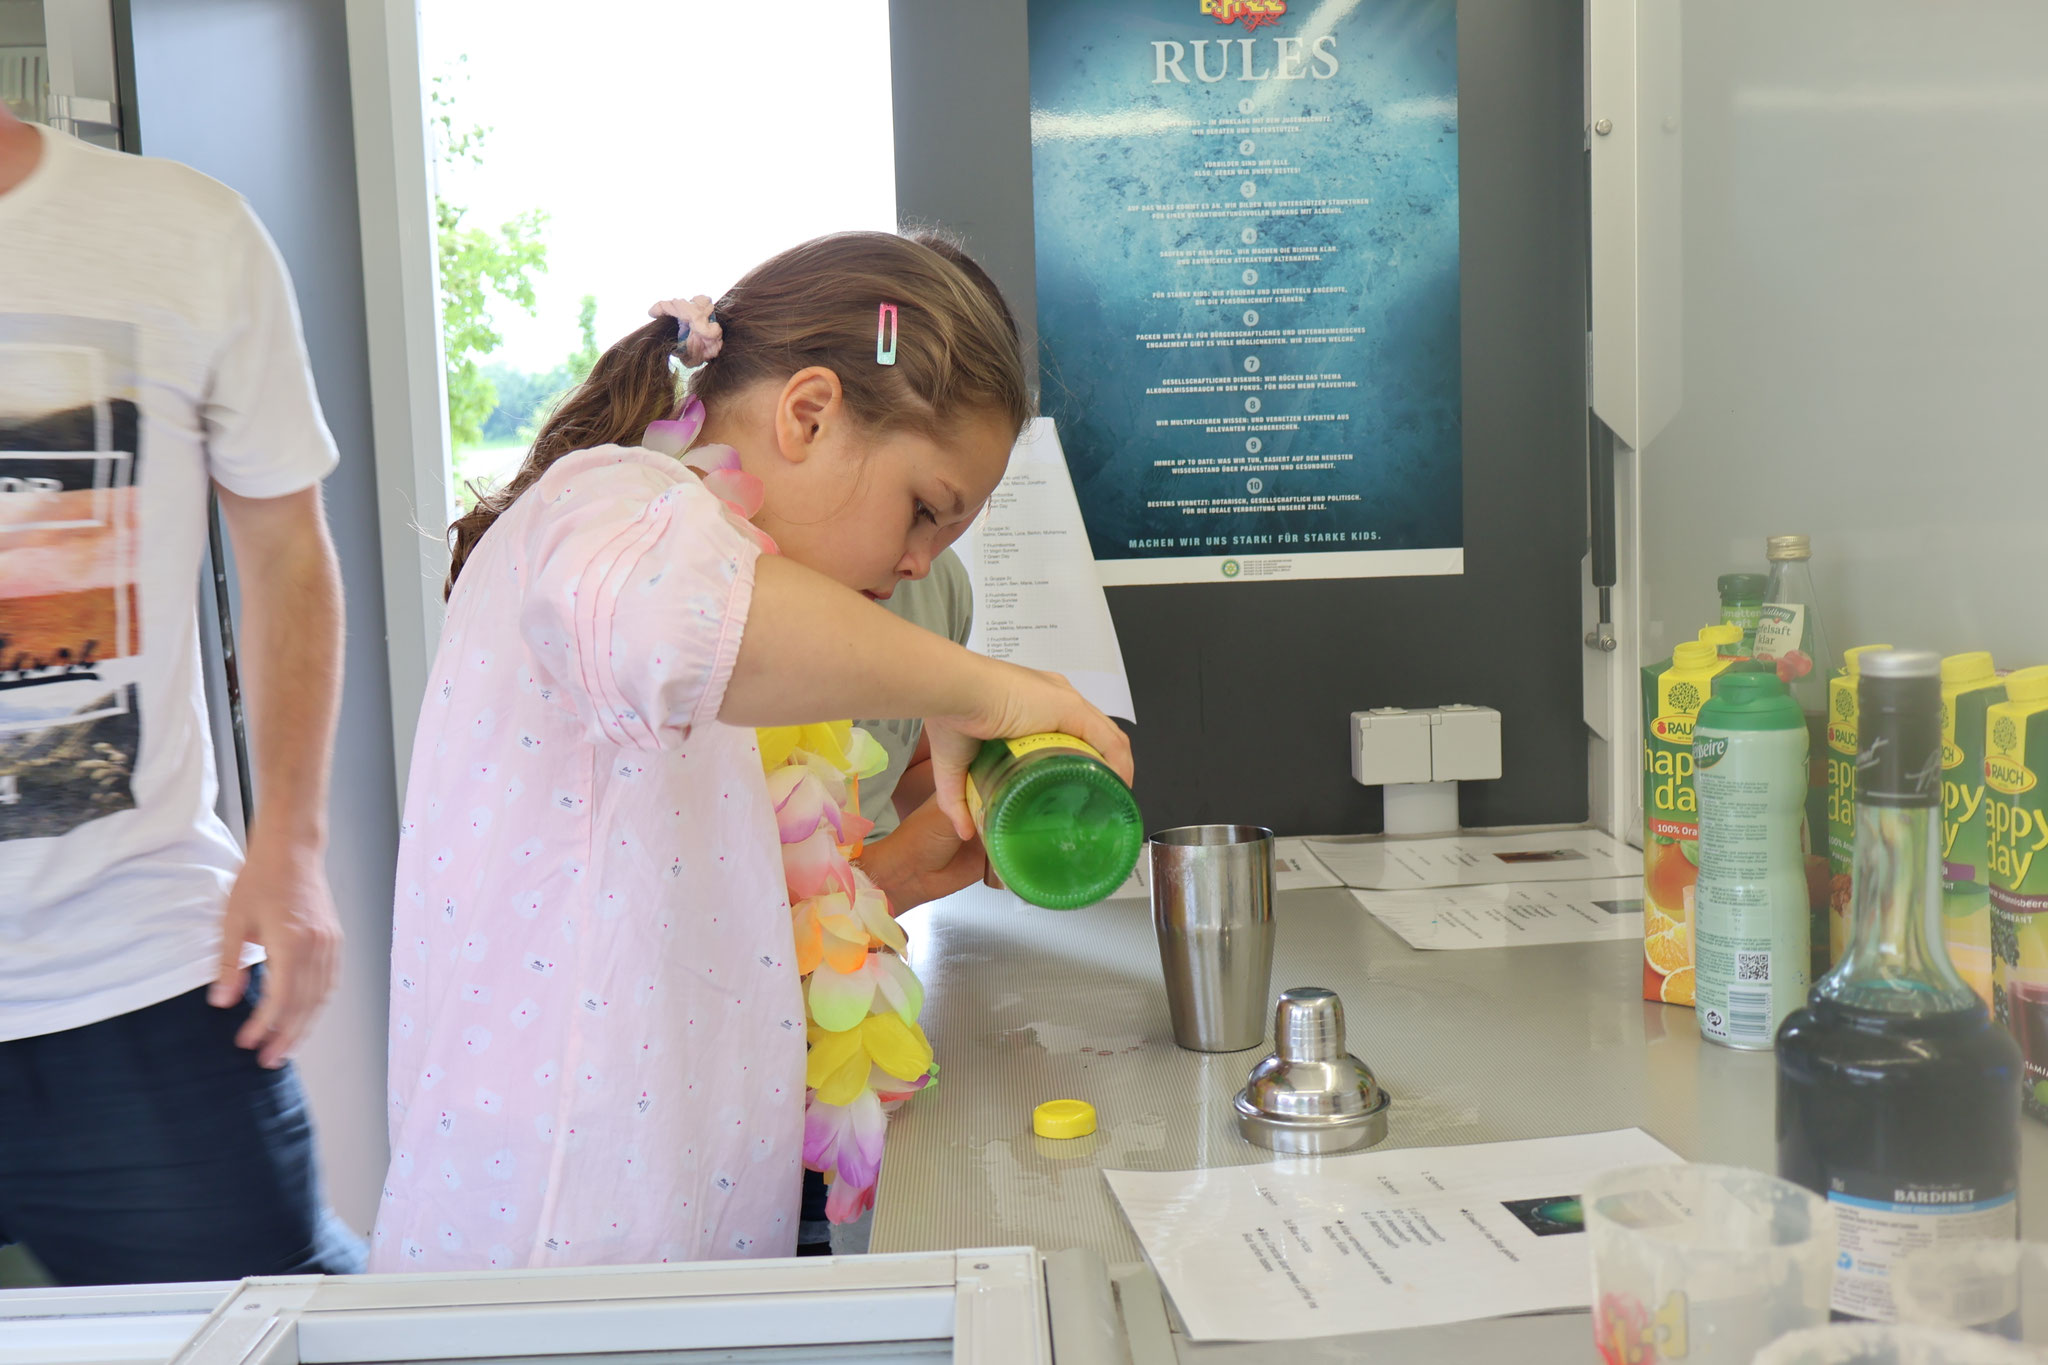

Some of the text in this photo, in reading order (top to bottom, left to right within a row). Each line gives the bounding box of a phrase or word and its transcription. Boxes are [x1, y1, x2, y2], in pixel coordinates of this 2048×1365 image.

[1151, 35, 1340, 84] RULES
[1246, 232, 1252, 240] 4
[1247, 273, 1253, 281] 5
[1248, 314, 1253, 322] 6
[1136, 332, 1160, 340] PACKEN
[1195, 331, 1208, 339] FÜR
[1210, 329, 1280, 338] BÜRGERSCHAFTLICHES
[1282, 328, 1295, 336] UND
[1297, 326, 1366, 336] UNTERNEHMERISCHES
[1146, 340, 1188, 348] ENGAGEMENT
[1304, 336, 1326, 344] ZEIGEN
[1328, 335, 1355, 343] WELCHE.
[1249, 360, 1255, 368] 7
[1162, 376, 1231, 385] GESELLSCHAFTLICHER
[1233, 375, 1262, 383] DISKURS:
[1145, 385, 1214, 394] ALKOHOLMISSBRAUCH
[1216, 384, 1223, 392] IN
[1278, 382, 1295, 390] NOCH
[1316, 380, 1358, 389] PRÄVENTION.
[1170, 417, 1220, 425] MULTIPLIZIEREN
[1206, 423, 1300, 433] RELEVANTEN FACHBEREICHEN.
[1251, 441, 1256, 449] 9
[1197, 457, 1216, 465] DATE:
[1233, 456, 1245, 464] WIR
[1263, 455, 1289, 463] BASIERT
[1321, 453, 1353, 461] NEUESTEN
[1171, 465, 1220, 474] WISSENSSTAND
[1240, 463, 1279, 472] PRÄVENTION
[1295, 462, 1336, 470] GESUNDHEIT.
[1250, 482, 1259, 490] 10
[1147, 500, 1175, 508] BESTENS
[1176, 499, 1210, 507] VERNETZT:
[1211, 497, 1247, 505] ROTARISCH,
[1250, 495, 1310, 504] GESELLSCHAFTLICH
[1327, 494, 1361, 502] POLITISCH.
[1196, 506, 1207, 514] DIE
[1232, 504, 1274, 513] VERBREITUNG
[1276, 503, 1305, 511] UNSERER
[1307, 502, 1327, 510] ZIELE.
[1128, 531, 1381, 548] MACHEN WIR UNS STARK! FÜR STARKE KIDS.
[1758, 635, 1775, 645] klar
[1667, 722, 1697, 736] RAU
[1991, 763, 2024, 787] RAUCH
[1655, 777, 1697, 813] da
[1657, 824, 1680, 834] 100%
[1986, 831, 2034, 890] day
[1894, 1189, 1975, 1204] BARDINET
